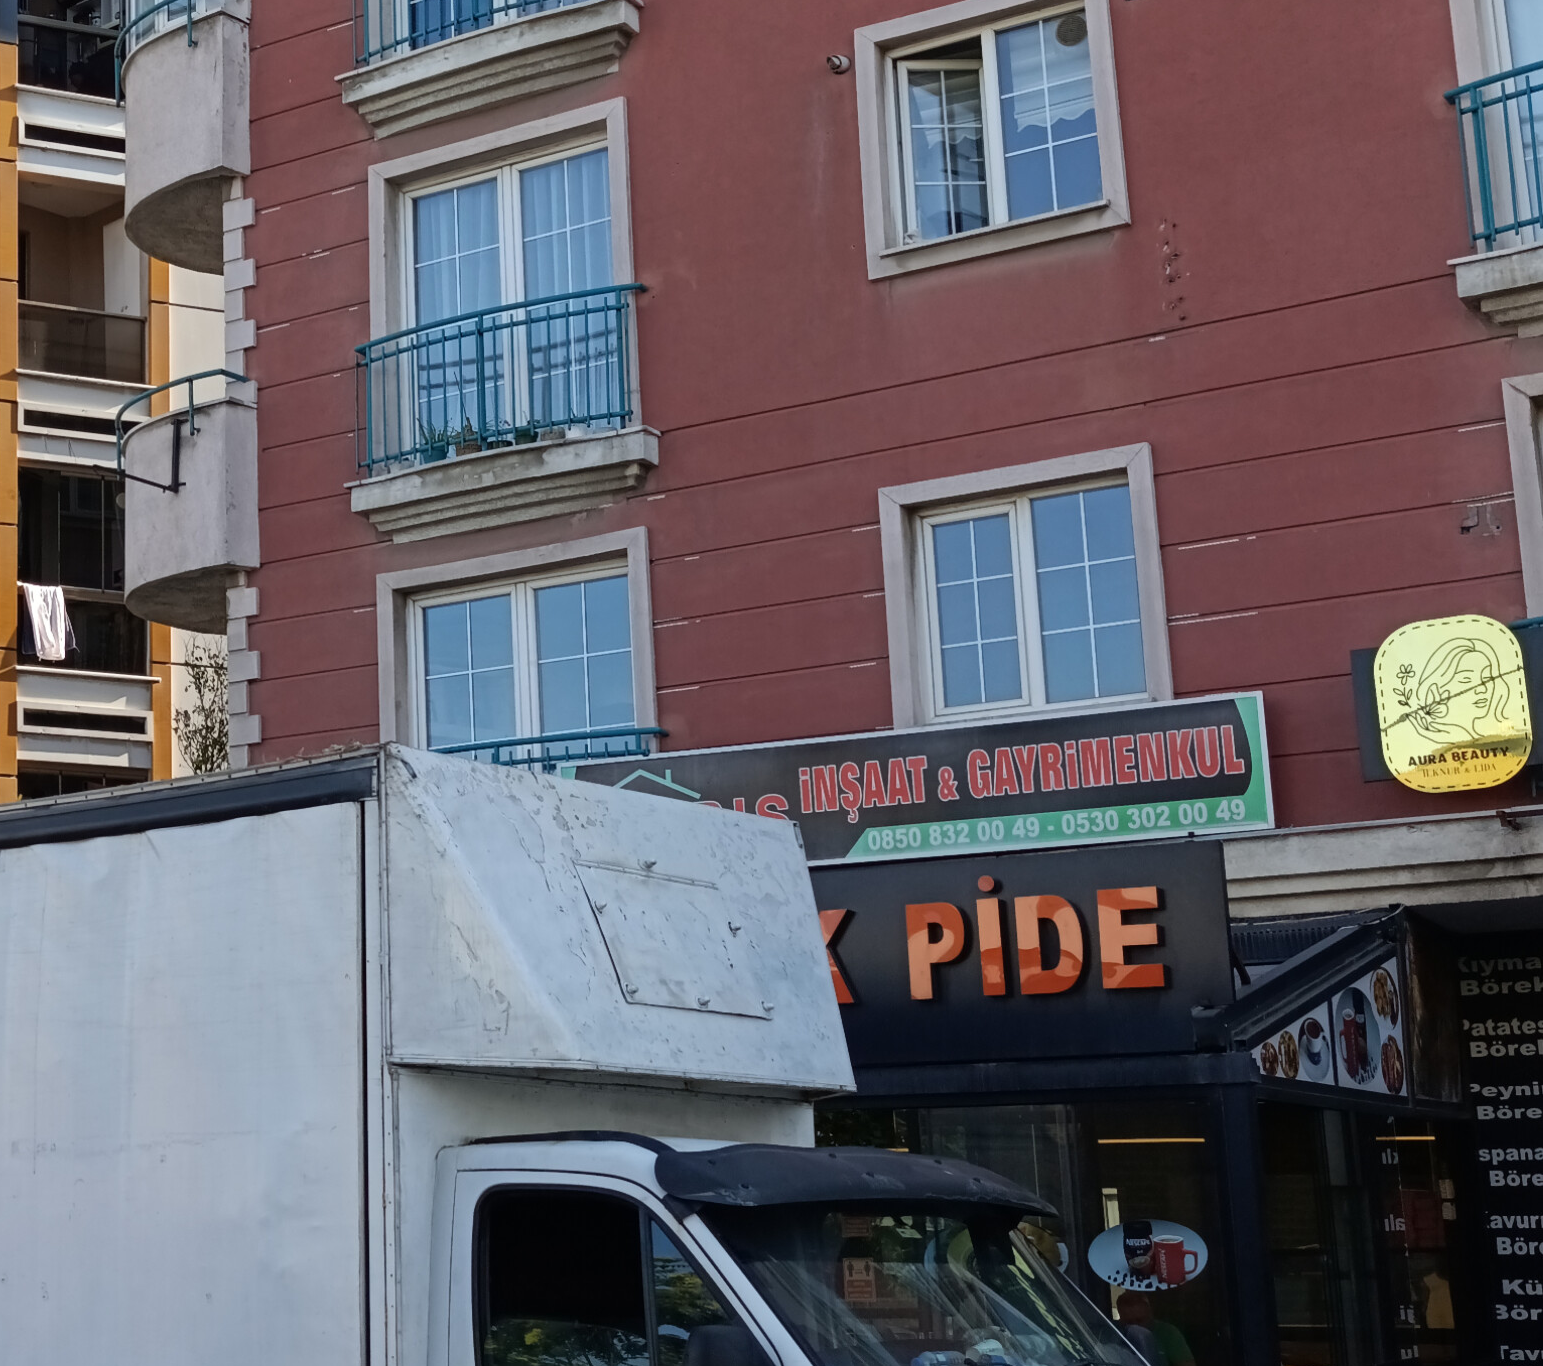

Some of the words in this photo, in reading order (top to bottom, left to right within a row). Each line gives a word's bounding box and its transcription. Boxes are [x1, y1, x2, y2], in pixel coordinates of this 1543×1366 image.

[1408, 755, 1448, 767] AURA
[1452, 746, 1509, 763] BEAUTY
[937, 766, 959, 801] &
[867, 826, 921, 851] 0850
[928, 822, 970, 846] 832
[976, 820, 1005, 842] 00
[1011, 816, 1040, 837] 49
[1061, 809, 1119, 835] 0530
[1127, 804, 1171, 829] 302
[1177, 802, 1208, 824] 00
[1215, 798, 1246, 821] 49
[905, 874, 1164, 1000] PİDE
